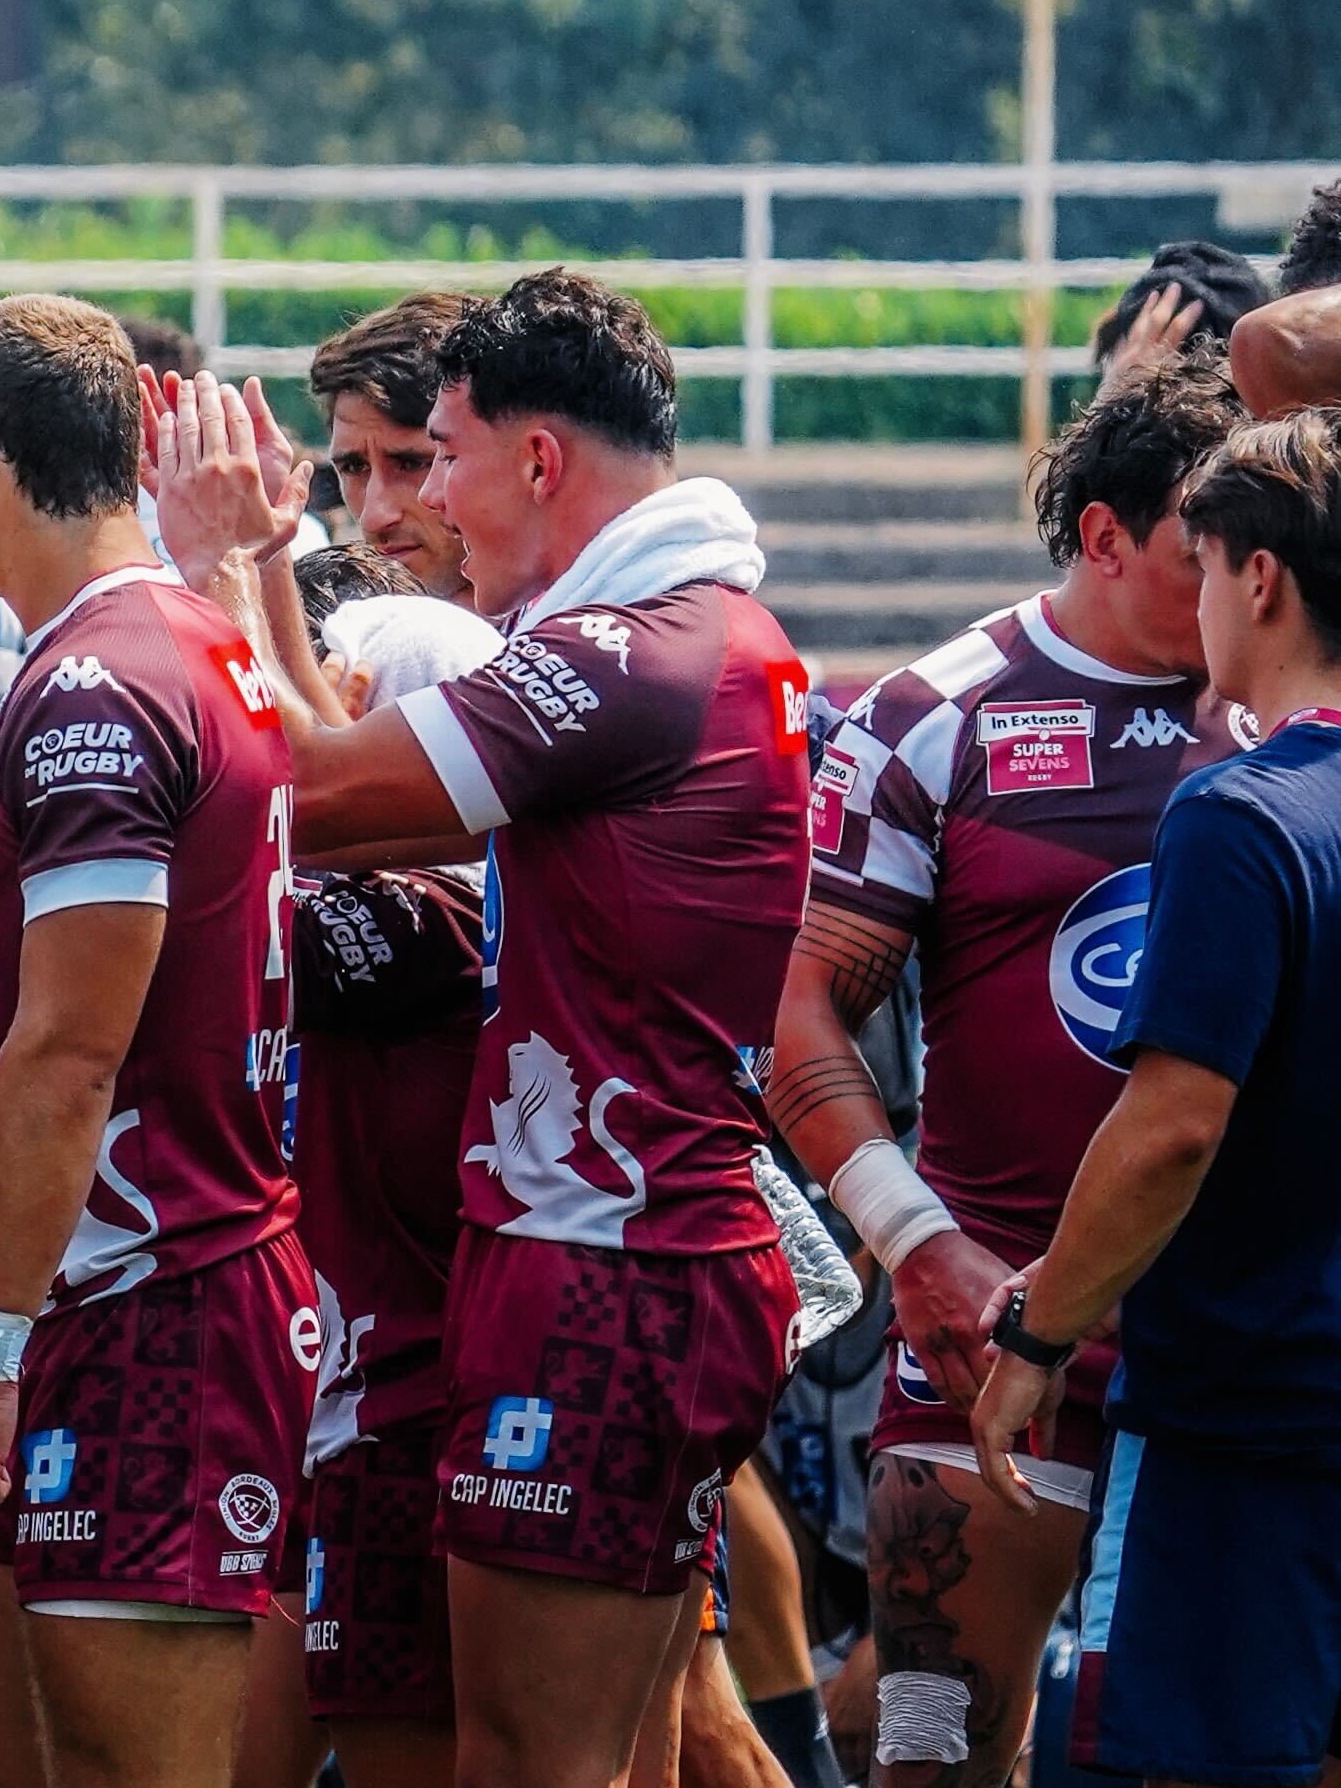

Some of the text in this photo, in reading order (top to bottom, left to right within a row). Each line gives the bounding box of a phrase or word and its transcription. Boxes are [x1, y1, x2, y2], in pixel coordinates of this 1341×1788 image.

[492, 651, 587, 732] RUGBY
[991, 714, 1079, 729] In Extenso
[24, 722, 133, 762] COEUR
[1013, 742, 1065, 758] SUPER
[37, 751, 144, 787] RUGBY
[1009, 757, 1070, 772] SEVENS
[451, 1473, 572, 1515] CAP INGELEC
[30, 1510, 96, 1543] INGELEC
